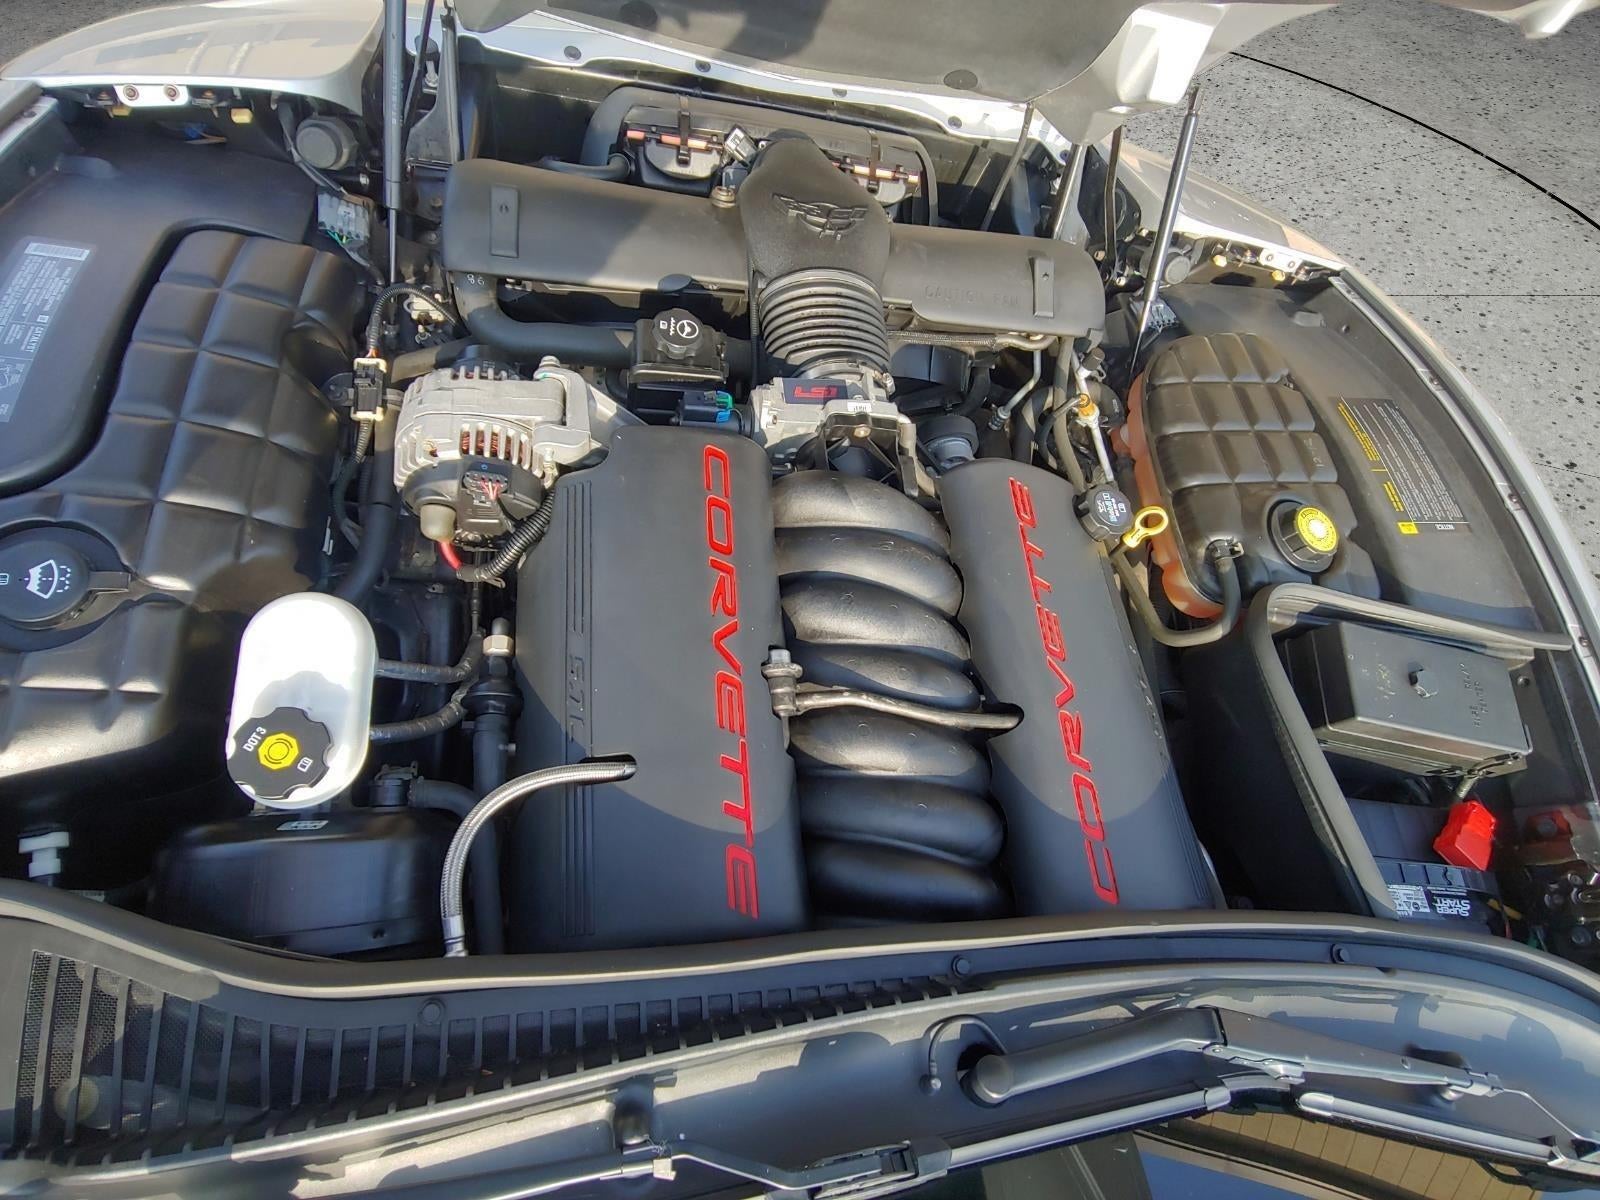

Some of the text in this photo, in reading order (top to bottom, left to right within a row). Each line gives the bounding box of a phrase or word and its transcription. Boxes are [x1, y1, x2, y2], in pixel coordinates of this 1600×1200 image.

[793, 385, 838, 398] LS1
[703, 443, 759, 920] CORVETTE
[1008, 475, 1119, 905] CORVETTE
[242, 726, 267, 752] DOT 3
[1435, 897, 1471, 910] START
[1437, 905, 1470, 917] SUPER
